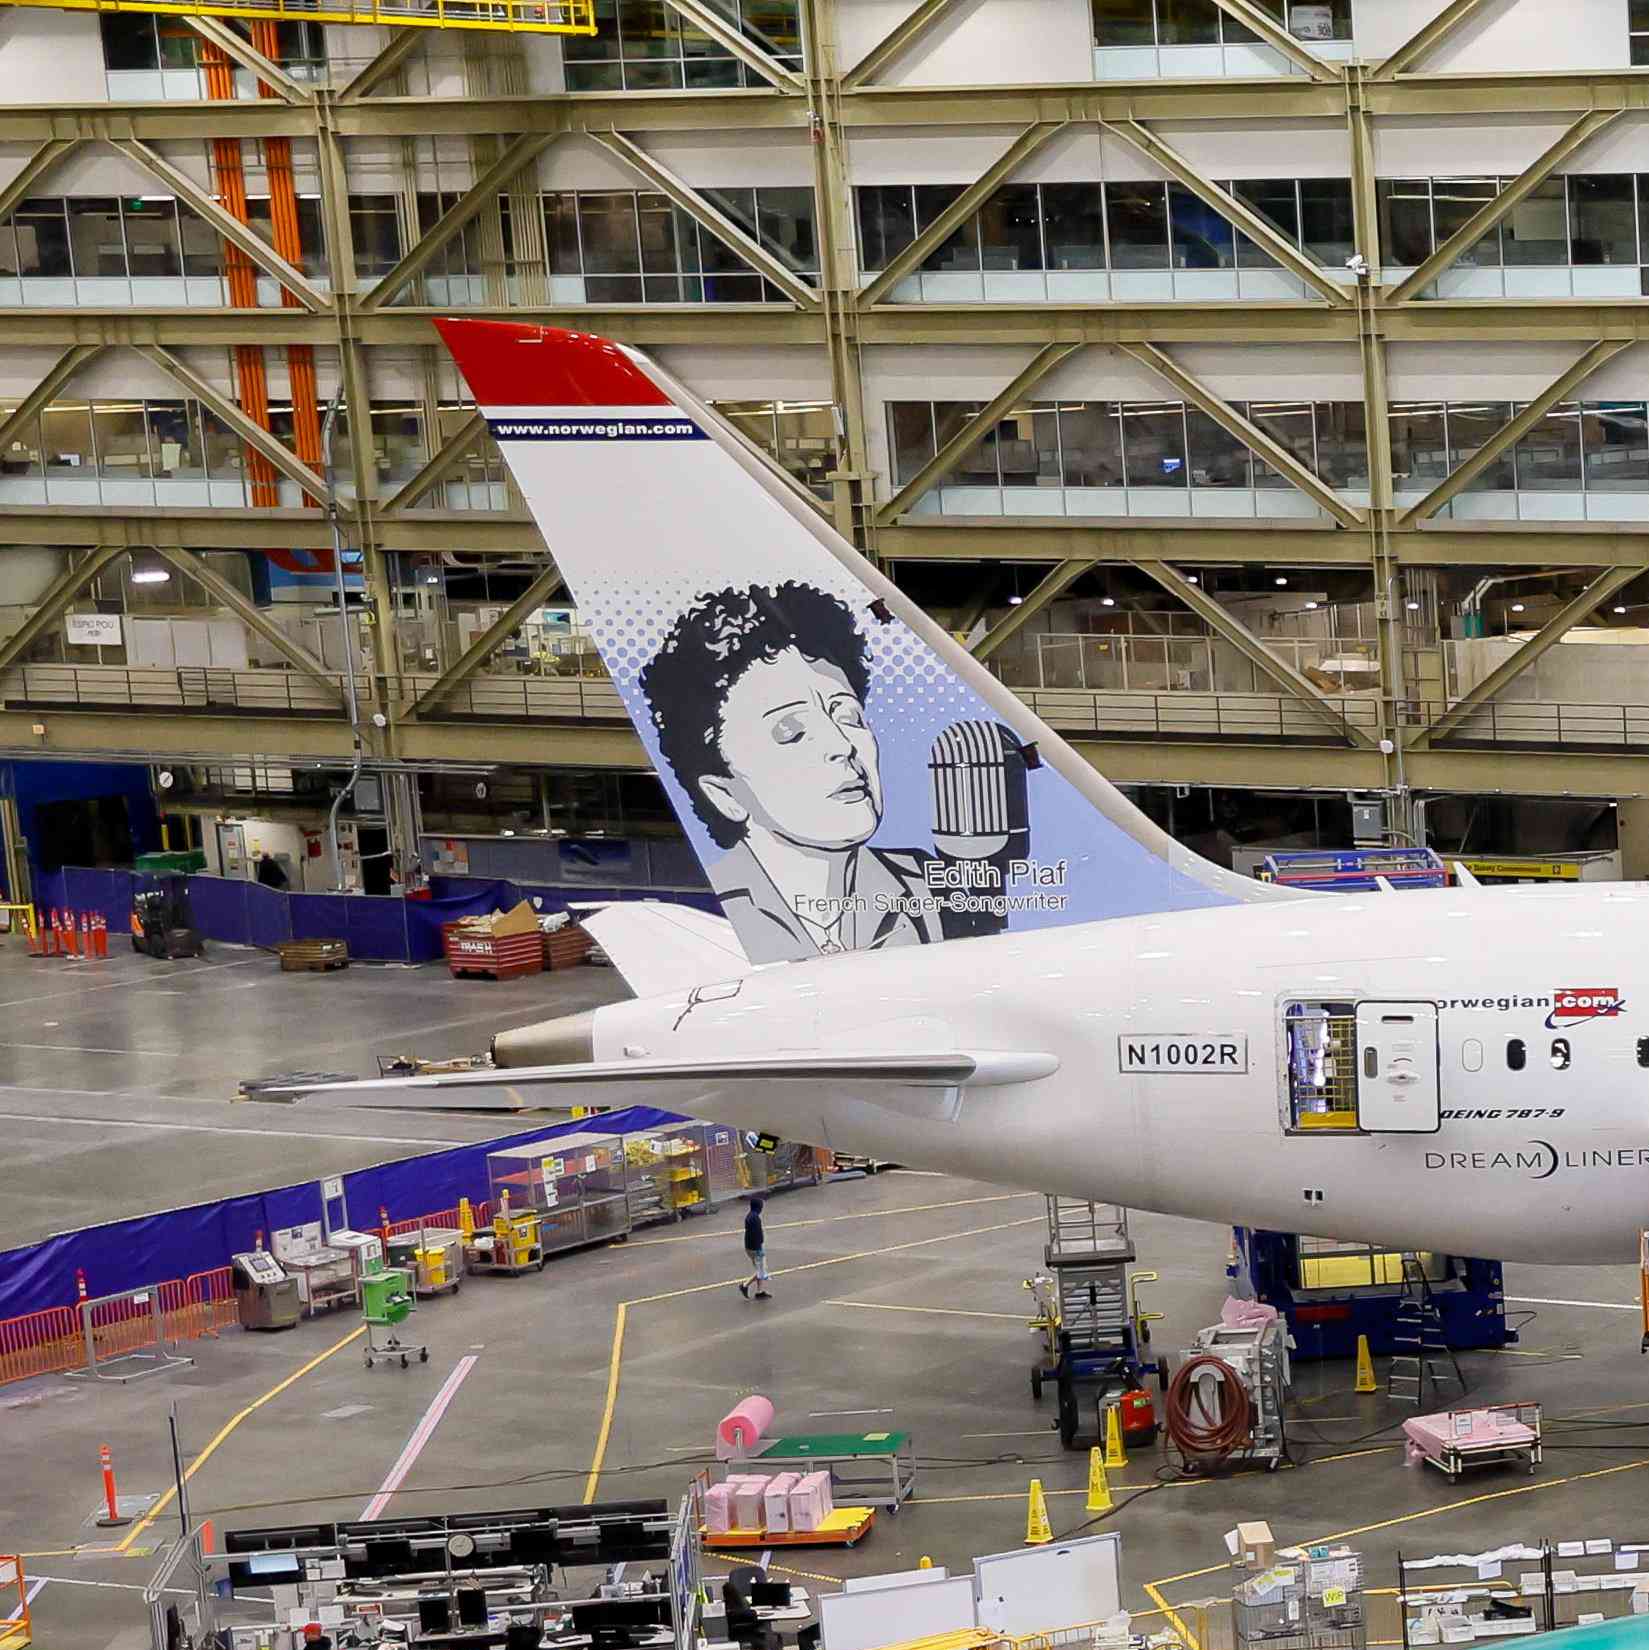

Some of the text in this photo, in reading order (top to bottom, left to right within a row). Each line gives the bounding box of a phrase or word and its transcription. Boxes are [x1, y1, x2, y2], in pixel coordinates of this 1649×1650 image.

[497, 422, 693, 438] www.norwegian.com
[926, 860, 1066, 887] Edith Piaf
[794, 894, 1067, 917] French Singer-Songwriter
[1128, 1043, 1239, 1065] N1002R
[1439, 1108, 1566, 1119] OEING 787-9
